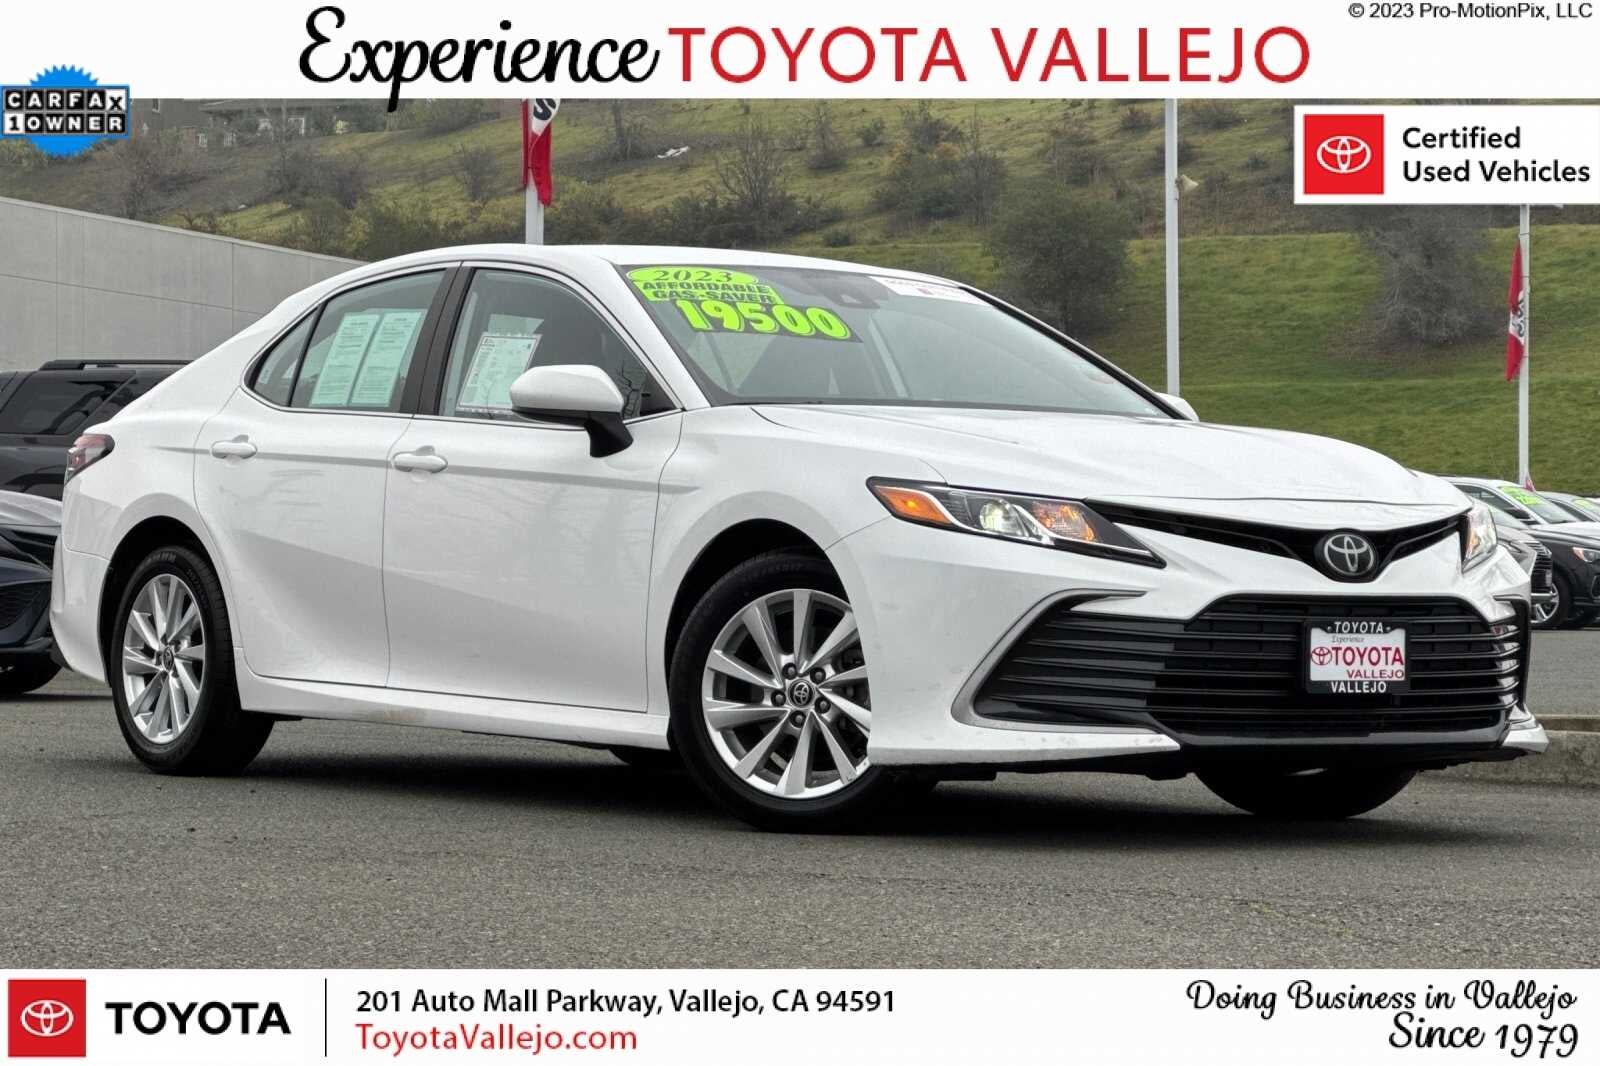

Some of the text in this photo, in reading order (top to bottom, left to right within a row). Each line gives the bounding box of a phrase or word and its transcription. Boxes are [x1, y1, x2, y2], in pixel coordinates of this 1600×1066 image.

[652, 269, 733, 283] 2023
[642, 281, 771, 294] AFFORDABLE
[676, 299, 850, 340] 19500
[1334, 621, 1384, 634] TOYOTA
[1331, 646, 1404, 667] TOYOTA
[1346, 669, 1405, 679] VALLEJO
[1331, 681, 1387, 694] VALLEJO
